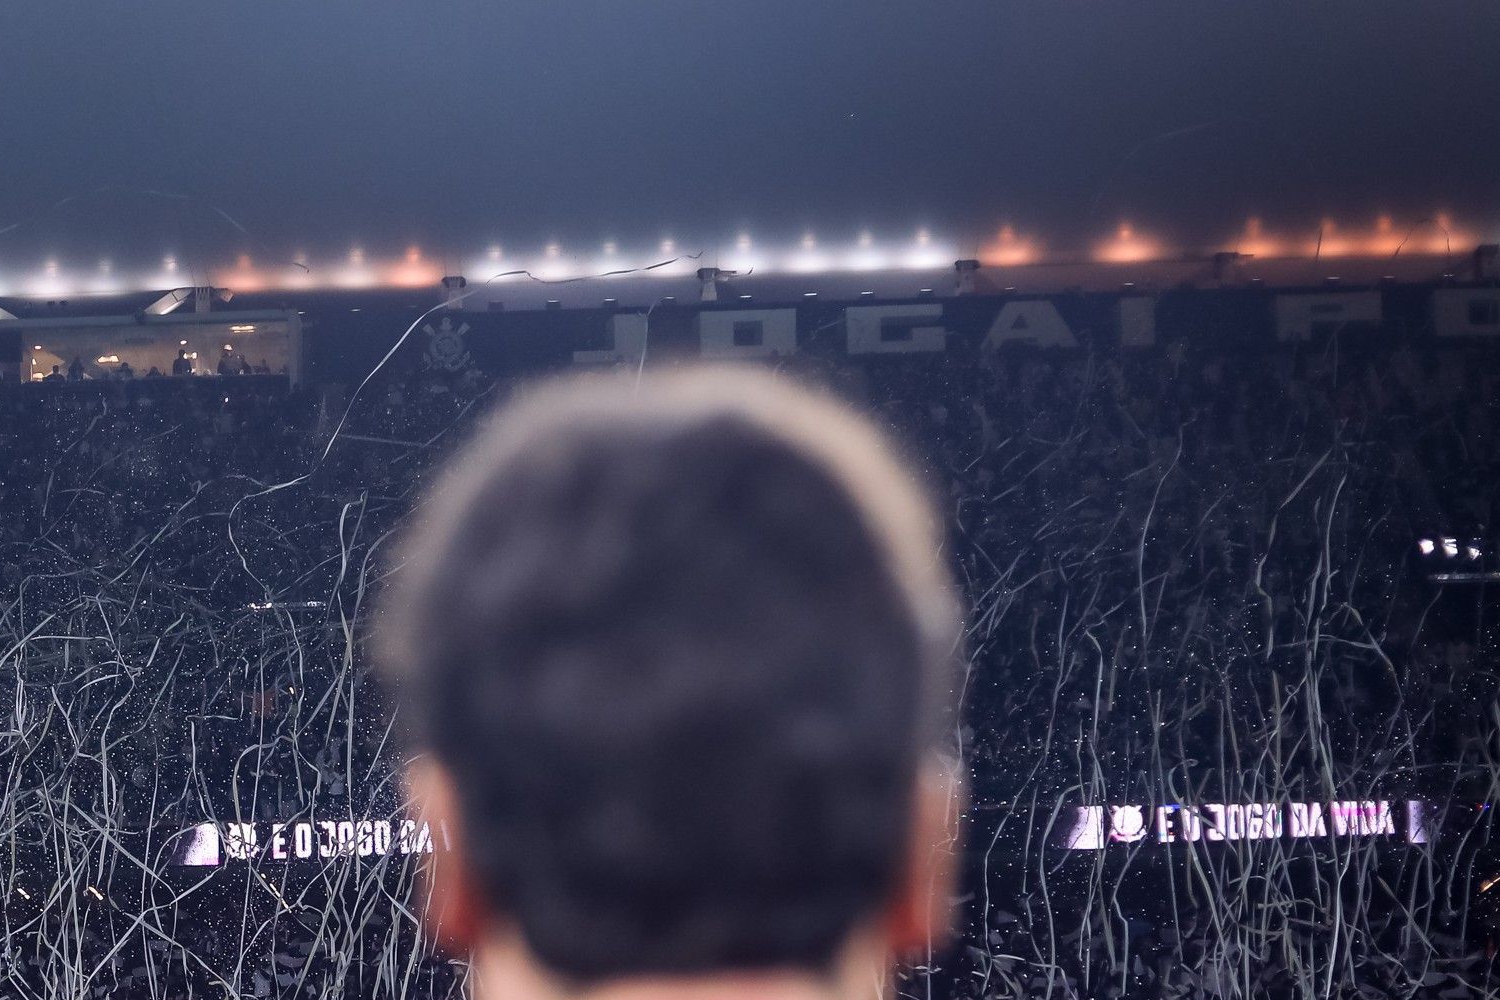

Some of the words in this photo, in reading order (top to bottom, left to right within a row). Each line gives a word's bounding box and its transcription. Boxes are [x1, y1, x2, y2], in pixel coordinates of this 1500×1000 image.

[1204, 803, 1283, 841] JOGO
[1291, 802, 1327, 837] DA
[295, 823, 312, 859] O
